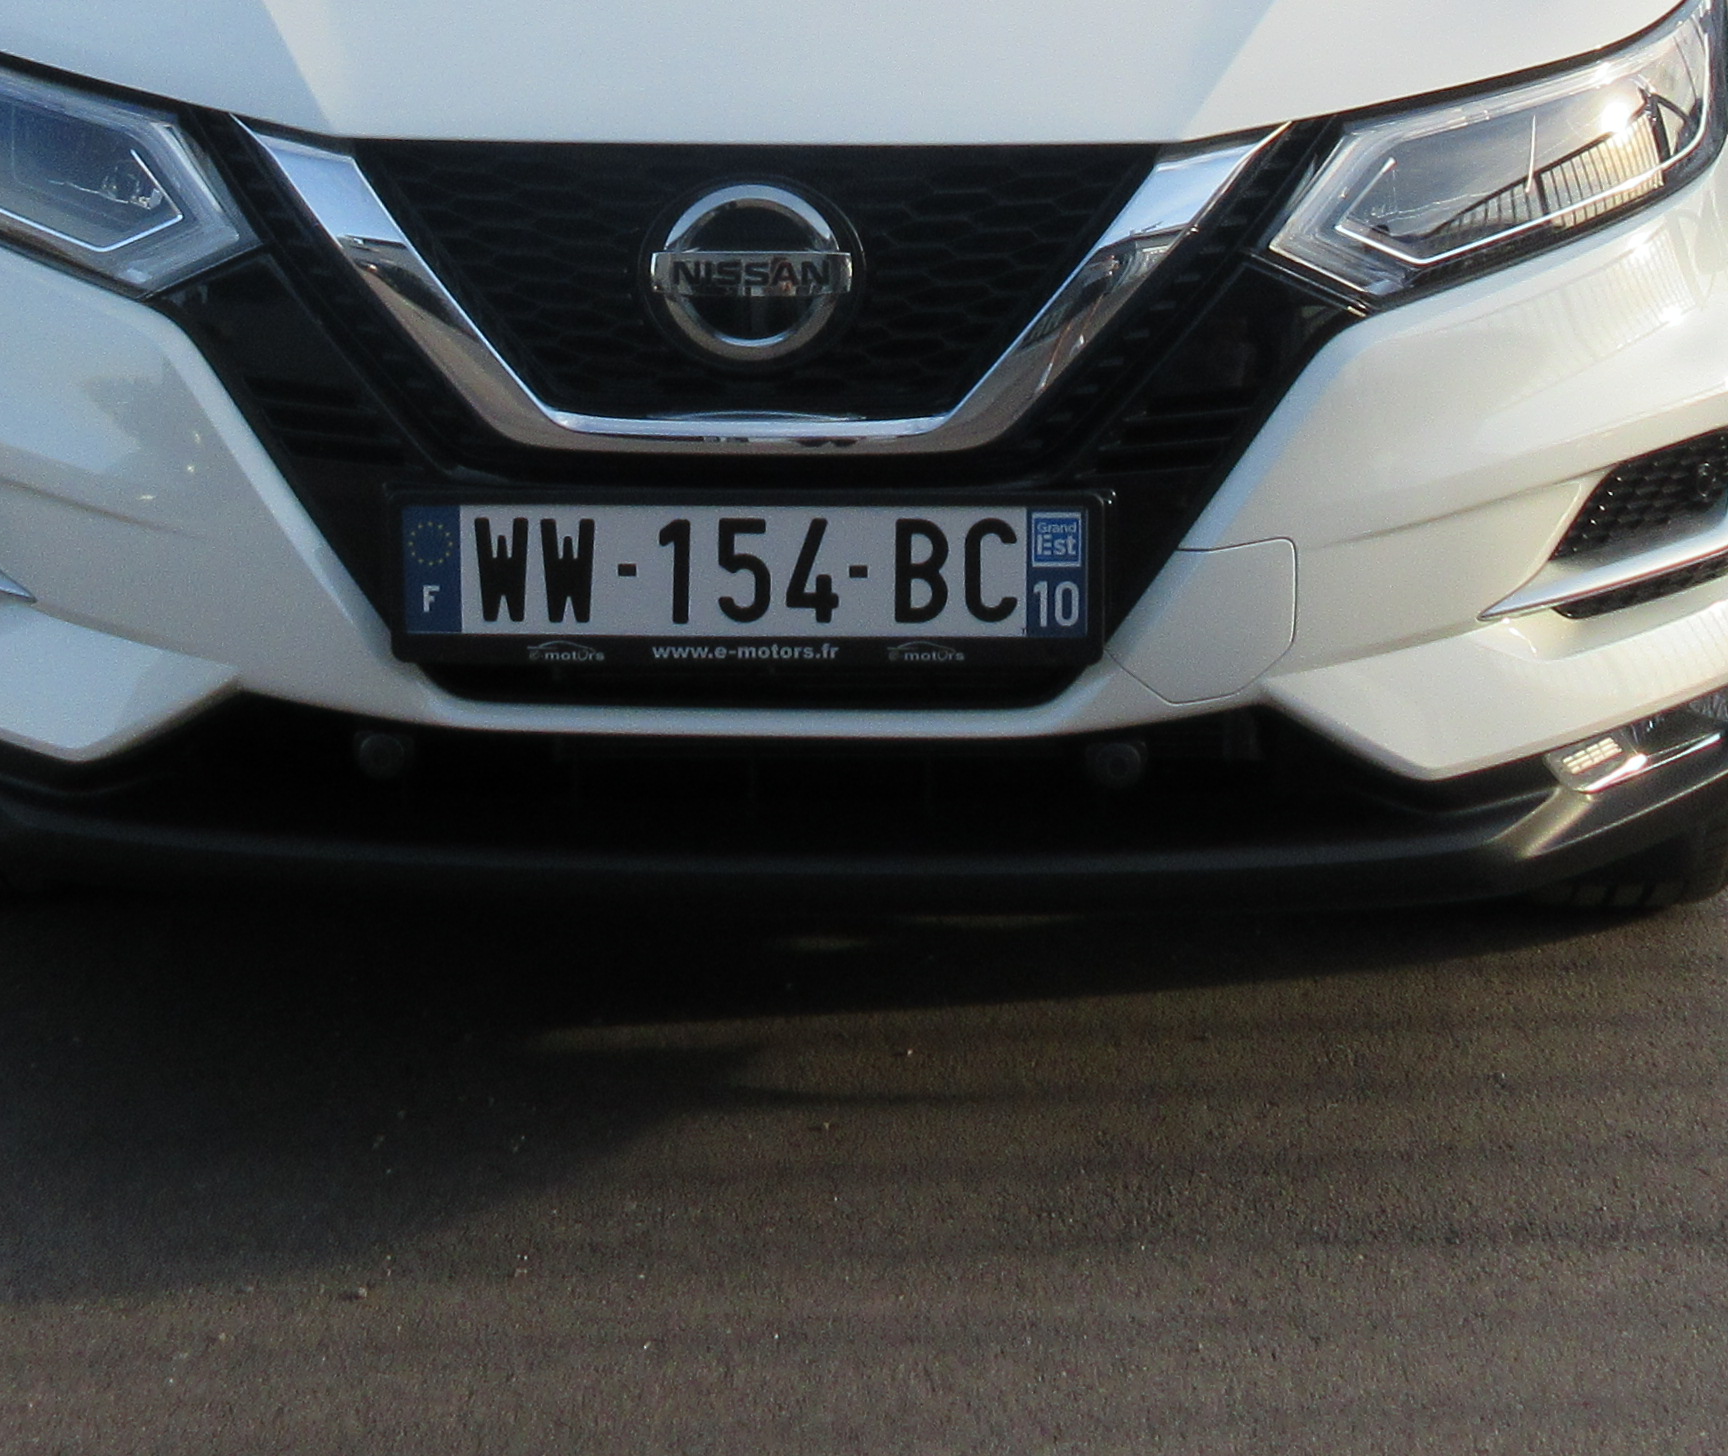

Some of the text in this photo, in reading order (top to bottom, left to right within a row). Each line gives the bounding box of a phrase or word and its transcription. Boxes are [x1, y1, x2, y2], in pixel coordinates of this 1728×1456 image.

[673, 259, 830, 287] NISSAN
[1036, 521, 1077, 533] Grand
[1036, 534, 1076, 555] Est
[474, 517, 1019, 623] WW-154-BC
[422, 584, 441, 613] F
[1033, 581, 1079, 626] 10
[652, 643, 839, 659] www.e-motors.fr
